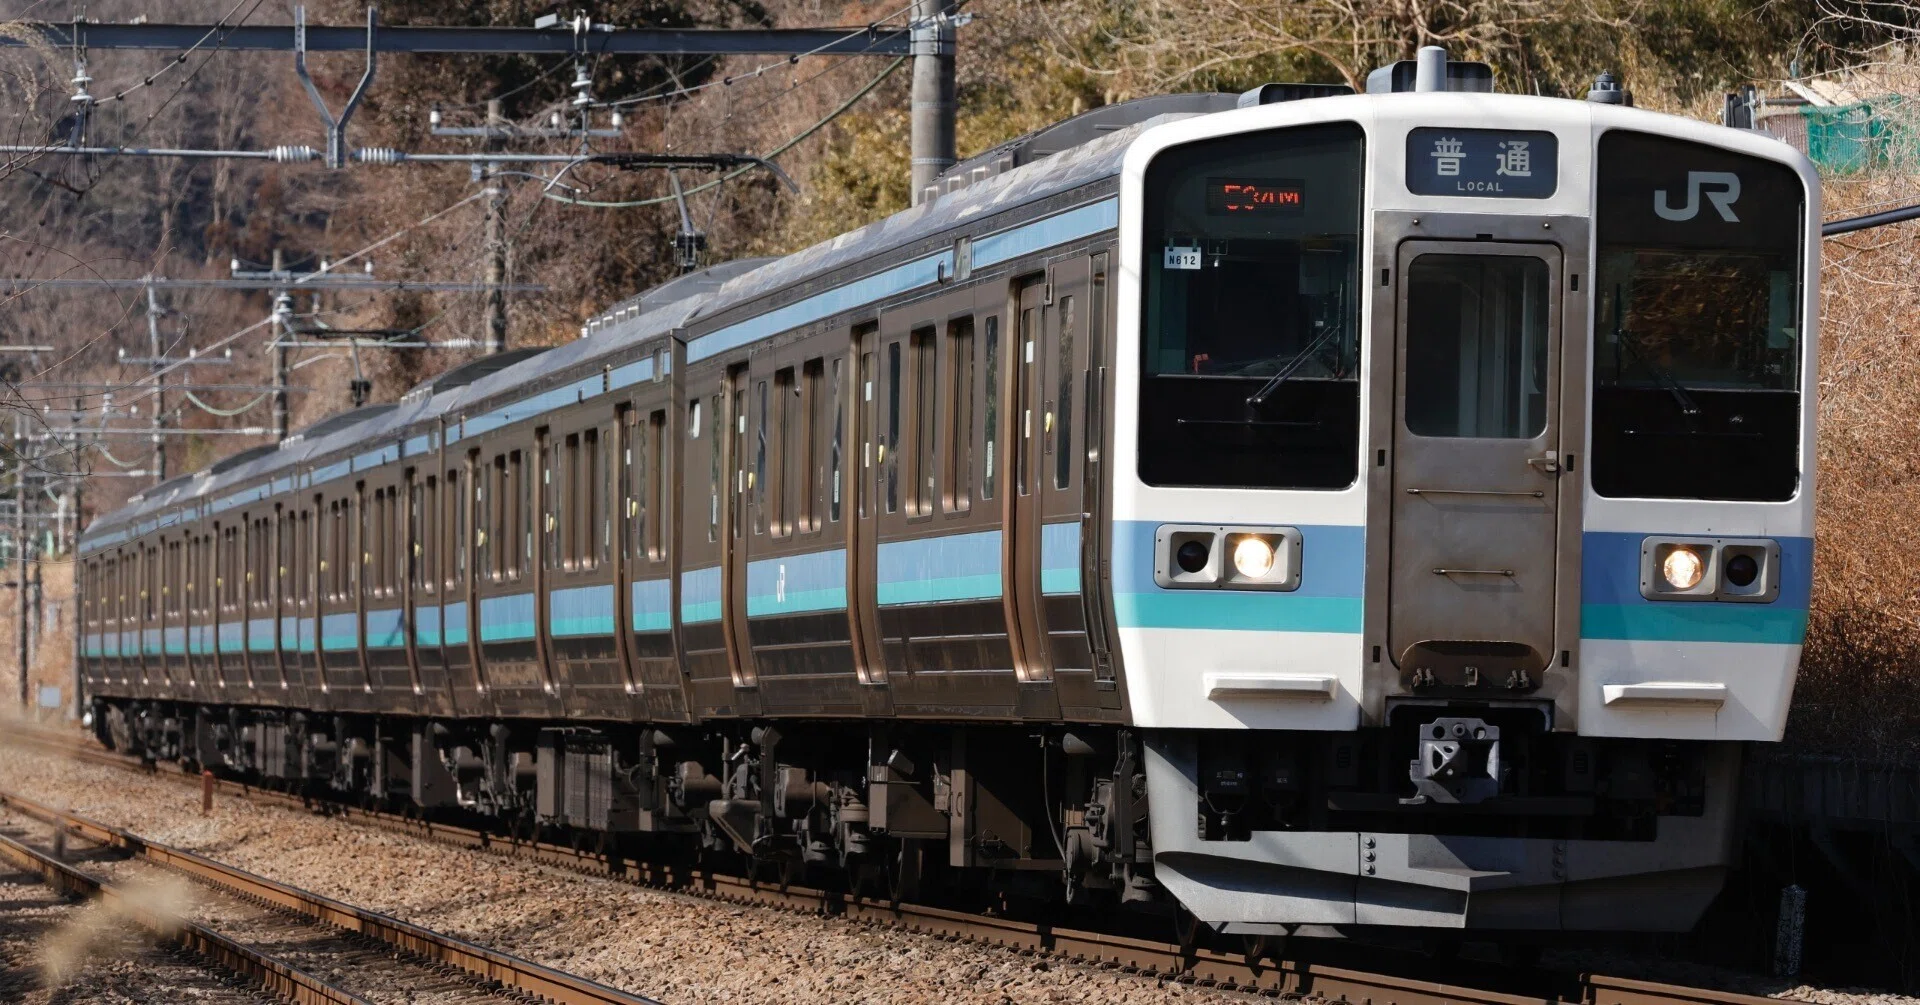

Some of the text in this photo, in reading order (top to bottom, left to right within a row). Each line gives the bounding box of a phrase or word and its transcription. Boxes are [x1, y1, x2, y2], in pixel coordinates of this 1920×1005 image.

[1430, 137, 1532, 177] 普通
[1457, 181, 1504, 192] LOCAL
[1654, 171, 1741, 223] JR
[1169, 255, 1196, 265] N612
